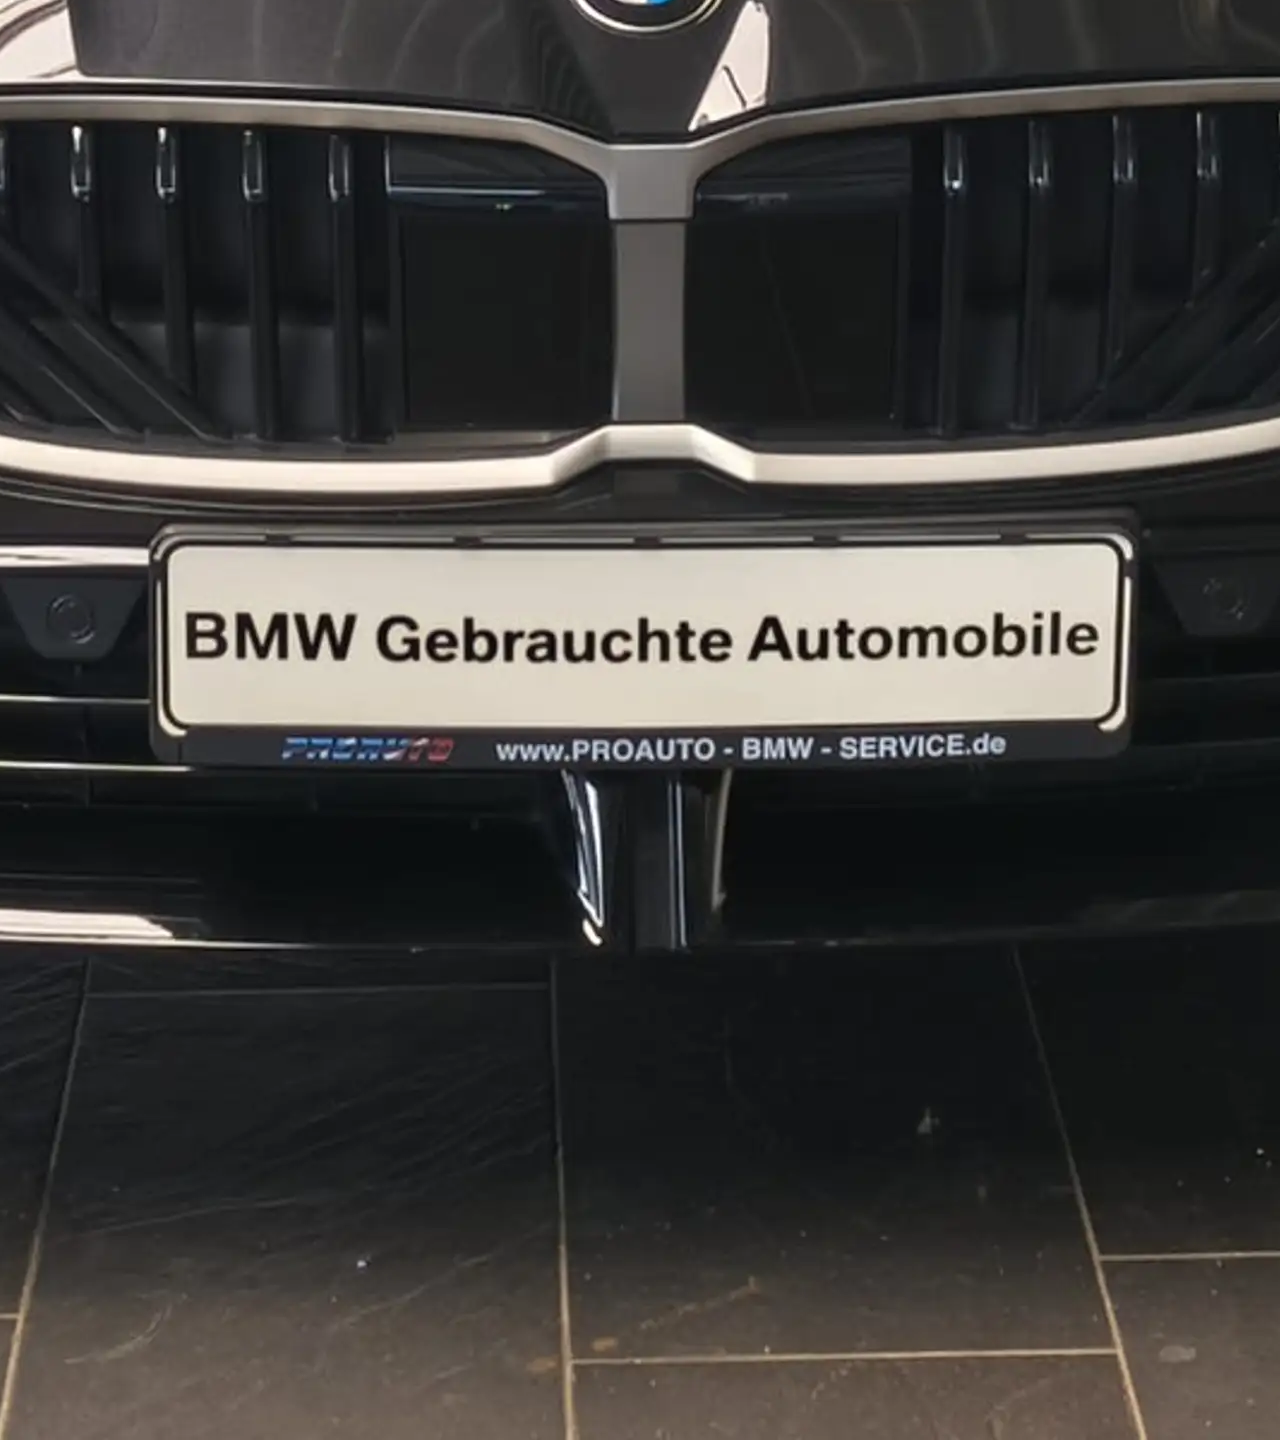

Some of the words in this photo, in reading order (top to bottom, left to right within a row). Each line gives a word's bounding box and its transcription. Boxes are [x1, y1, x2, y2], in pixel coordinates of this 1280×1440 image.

[185, 611, 357, 662] BMW
[376, 615, 733, 664] Gebrauchte
[746, 611, 1100, 662] Automobile
[496, 736, 716, 763] www.PROAUTO
[742, 737, 814, 761] BMW
[839, 732, 1007, 760] SERVICE.de
